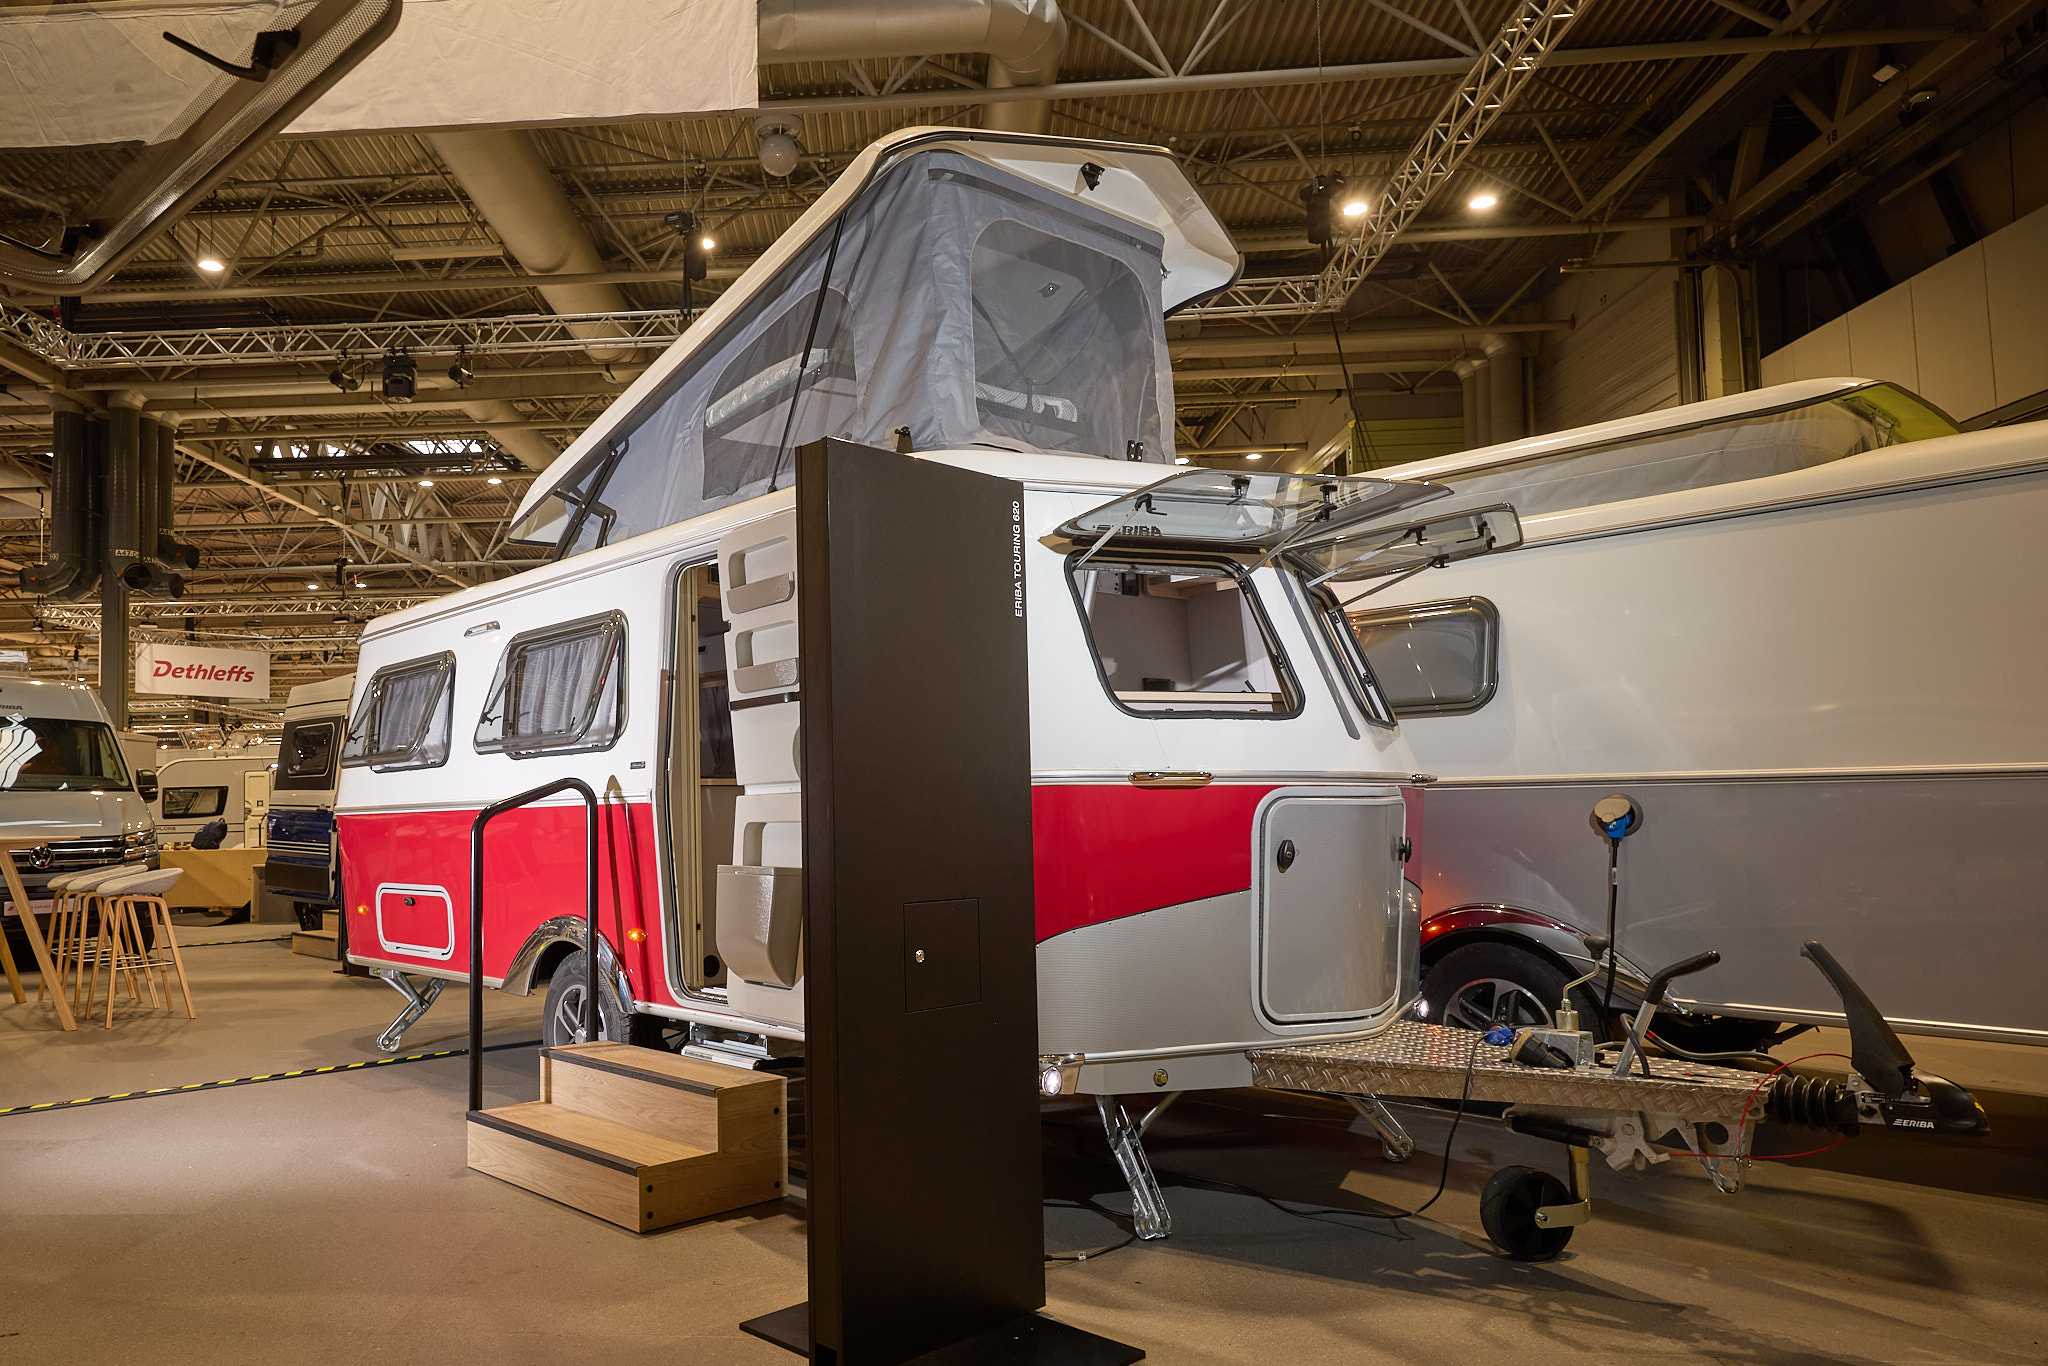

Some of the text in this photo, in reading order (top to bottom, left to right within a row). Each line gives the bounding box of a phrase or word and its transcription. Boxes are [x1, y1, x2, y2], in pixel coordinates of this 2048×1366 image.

[1826, 129, 1838, 145] 18
[1012, 500, 1023, 617] ERIBA TOURING 620
[153, 660, 254, 682] Dethleffs
[1902, 1119, 1935, 1129] ERIBA
